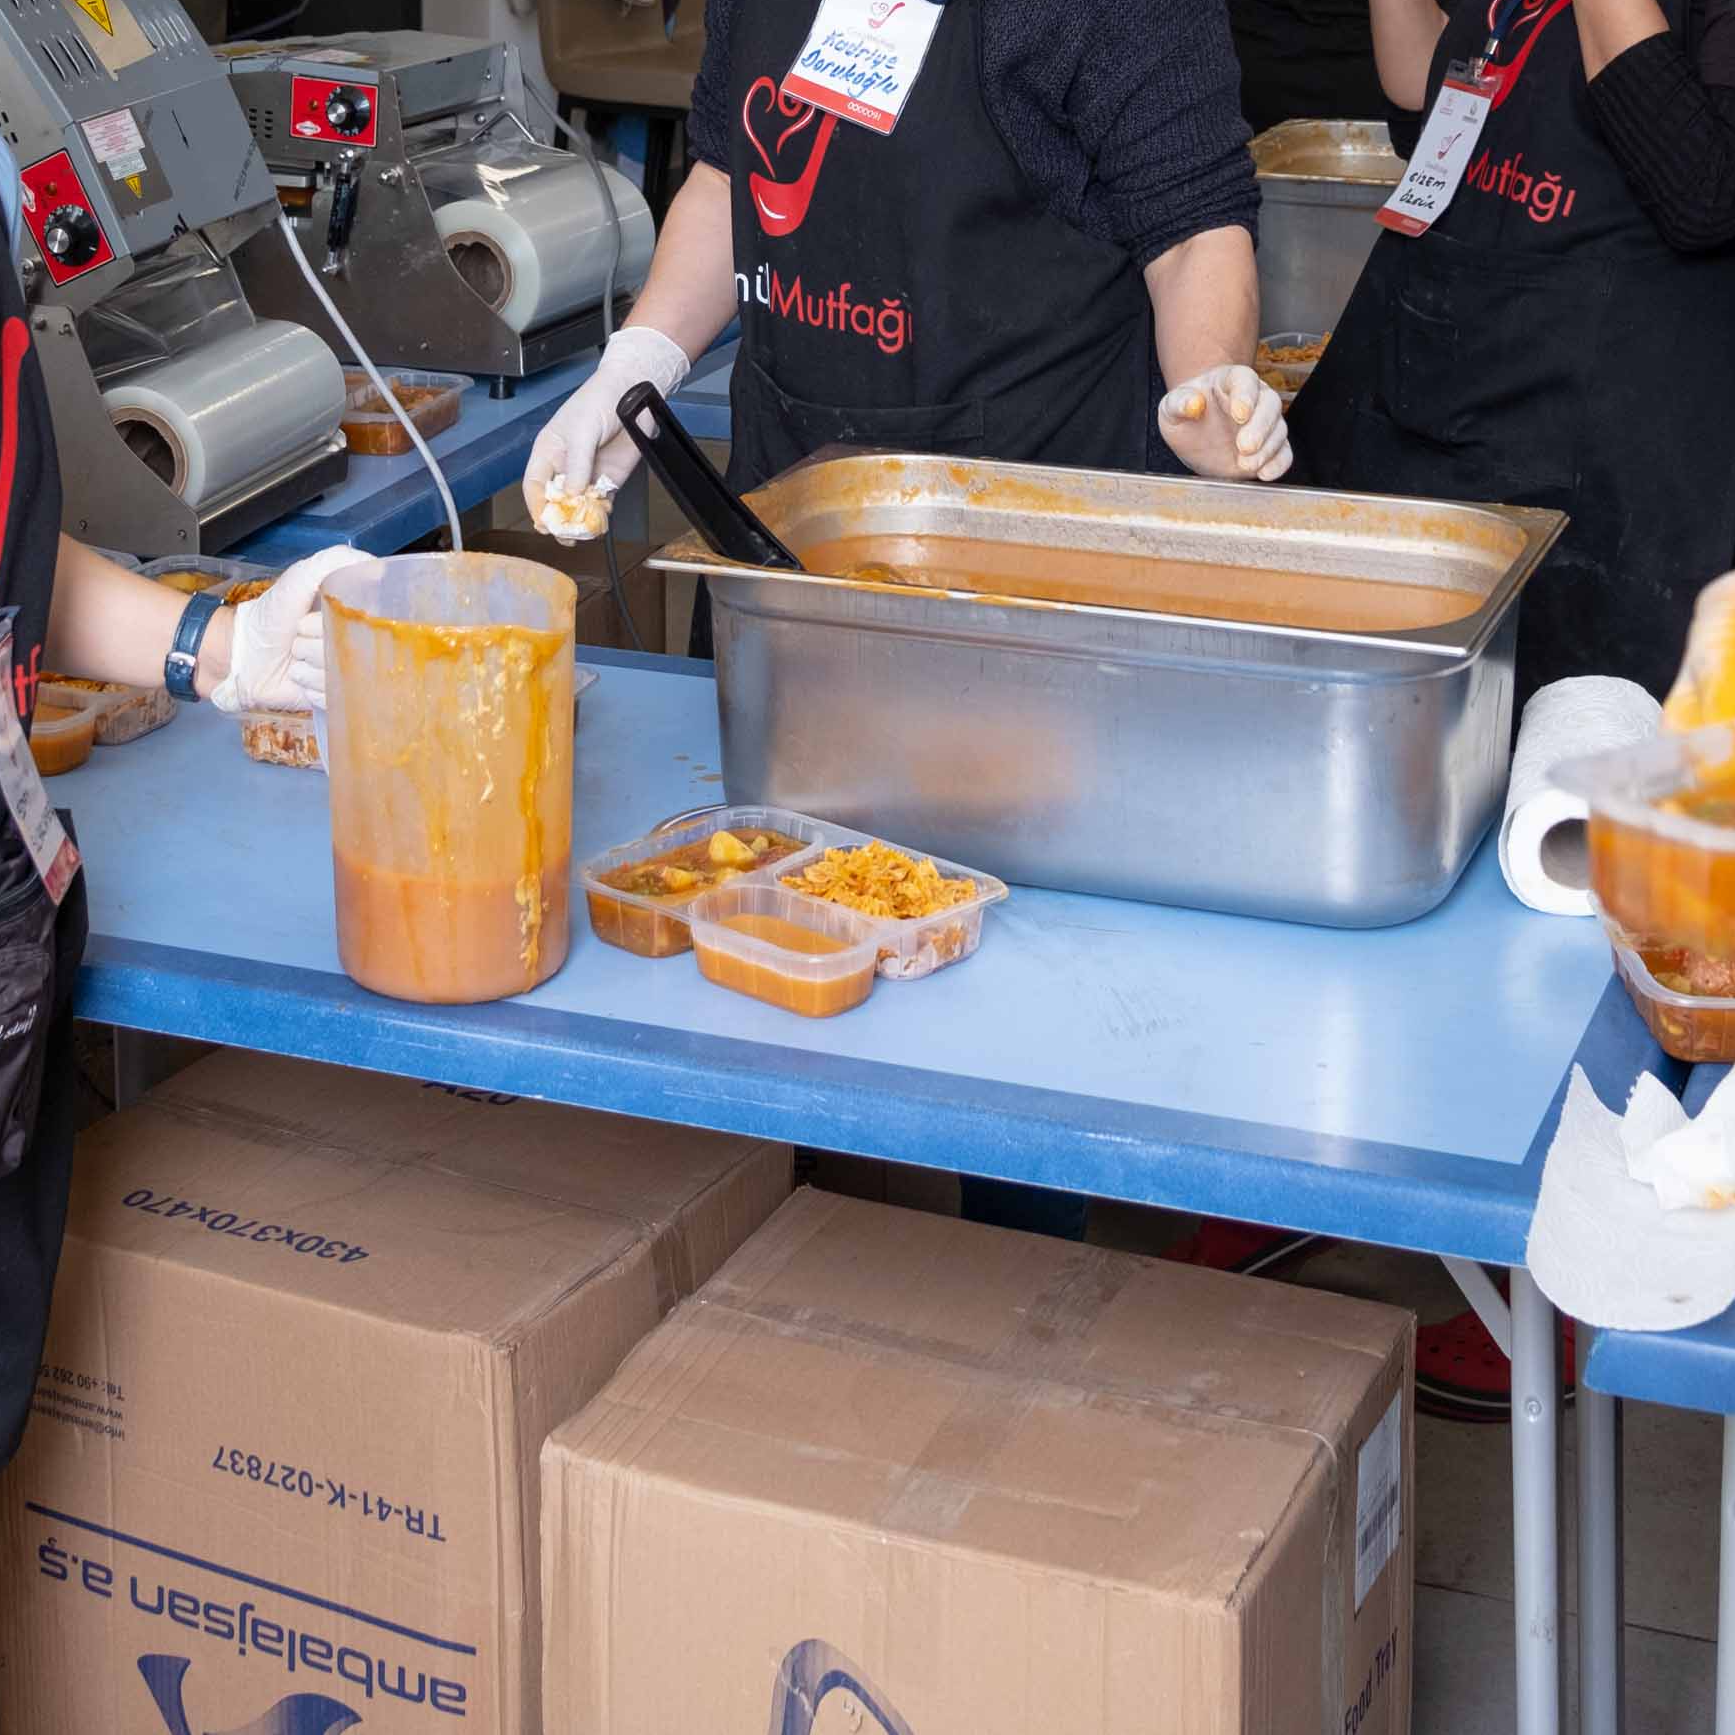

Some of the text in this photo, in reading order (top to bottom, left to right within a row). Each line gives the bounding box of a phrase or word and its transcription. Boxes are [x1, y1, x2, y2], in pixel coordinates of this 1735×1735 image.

[801, 49, 899, 98] Dorukoğlu
[822, 29, 898, 70] Kadriye
[122, 1188, 370, 1264] 430x370x470
[212, 1446, 447, 1542] TR-41-K-027837
[130, 1576, 466, 1716] ambalajsan
[1344, 1673, 1374, 1735] Food
